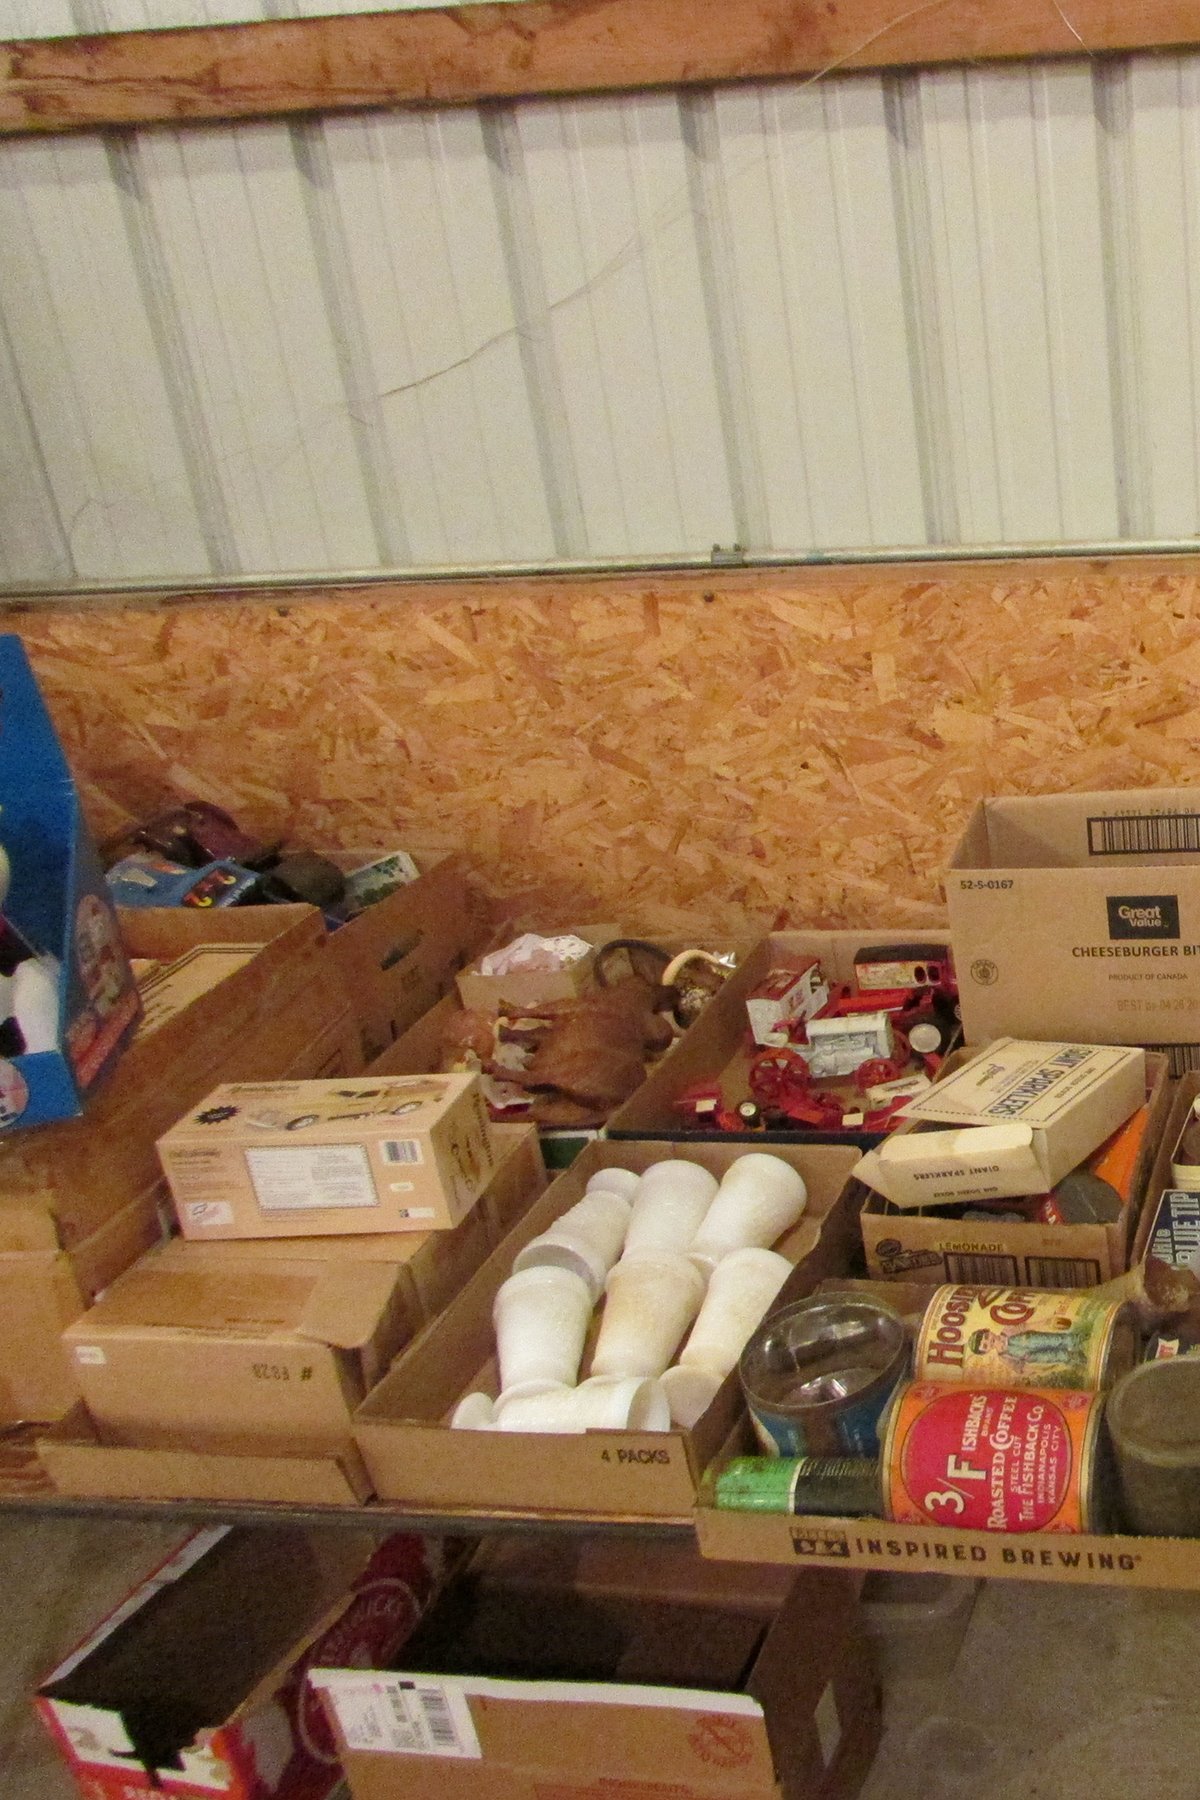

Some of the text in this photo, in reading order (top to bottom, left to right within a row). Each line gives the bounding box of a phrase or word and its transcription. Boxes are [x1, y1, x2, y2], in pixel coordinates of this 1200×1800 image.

[1118, 905, 1161, 919] Great
[1129, 917, 1162, 927] Value
[1072, 946, 1179, 958] CHEESEBURGER
[1145, 973, 1155, 981] OF
[1117, 999, 1141, 1012] BEST
[913, 1165, 999, 1180] GIANT SPARKLERS
[1170, 1193, 1200, 1218] TIP
[939, 1242, 1004, 1252] LEMONADE
[601, 1448, 671, 1464] 4 PACKS
[987, 1396, 1018, 1530] ROASTED COFFEE
[1010, 1436, 1022, 1493] STEEL CUT
[1018, 1423, 1040, 1496] FISHBACK
[1037, 1423, 1051, 1504] INDIANAPOLIS
[1047, 1425, 1062, 1505] KANSAS CITY
[1018, 1498, 1035, 1522] THE
[856, 1538, 987, 1562] INSPIRED
[1002, 1547, 1136, 1571] BREWING
